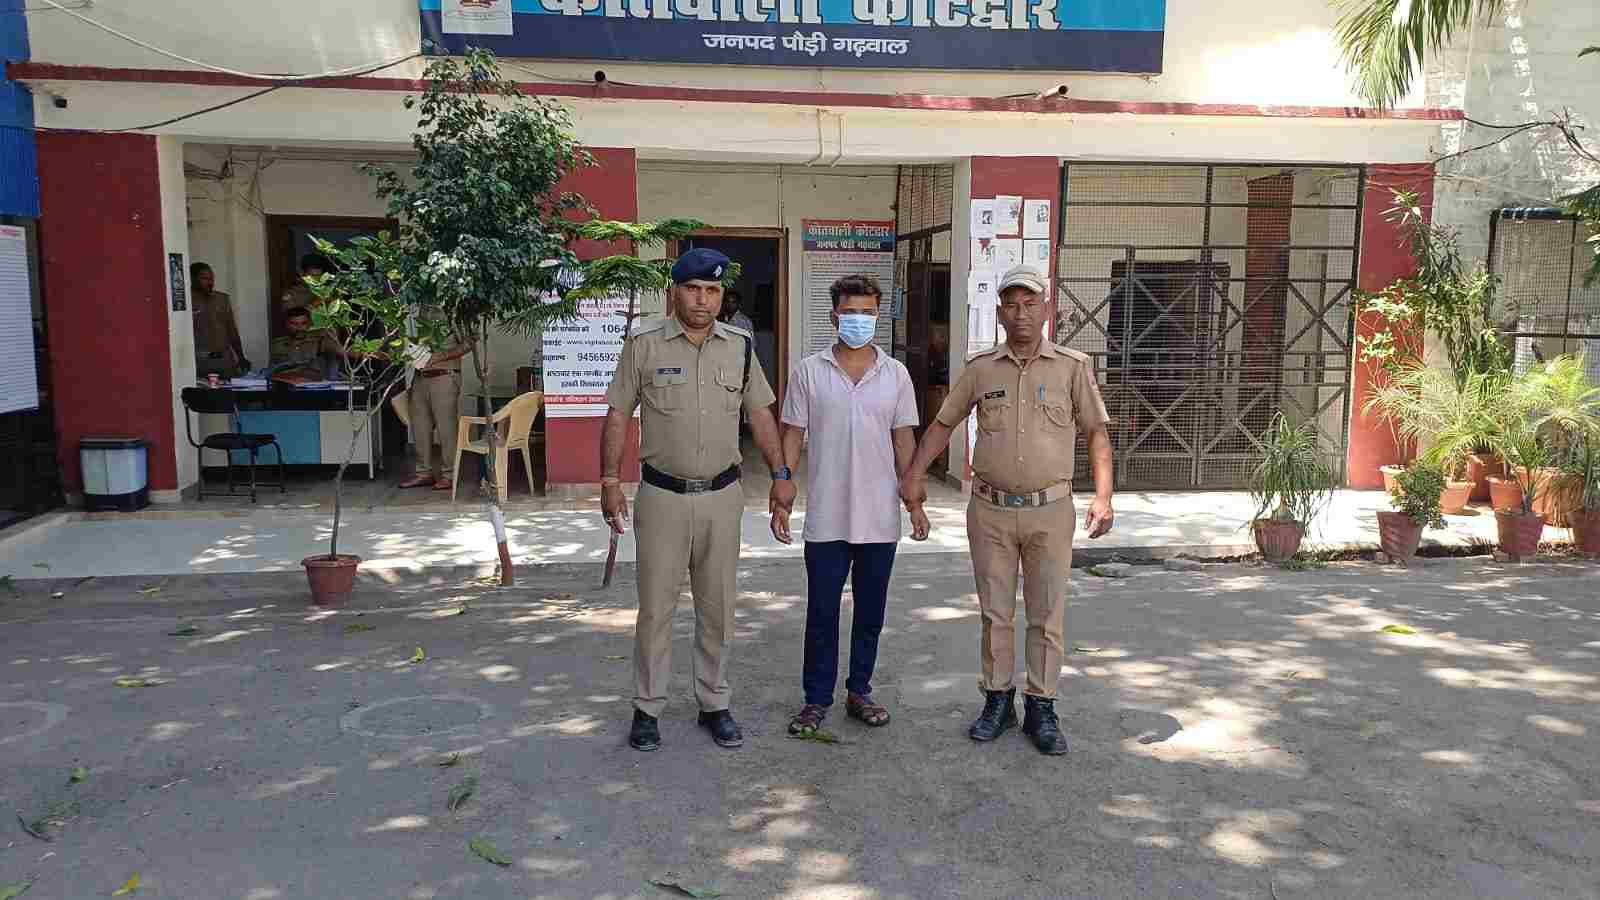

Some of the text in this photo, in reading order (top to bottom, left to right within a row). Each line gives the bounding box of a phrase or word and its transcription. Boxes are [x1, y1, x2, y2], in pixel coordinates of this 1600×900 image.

[702, 30, 910, 57] जनपद पौड़ी गढ़वाल
[808, 222, 850, 238] कोतवाली
